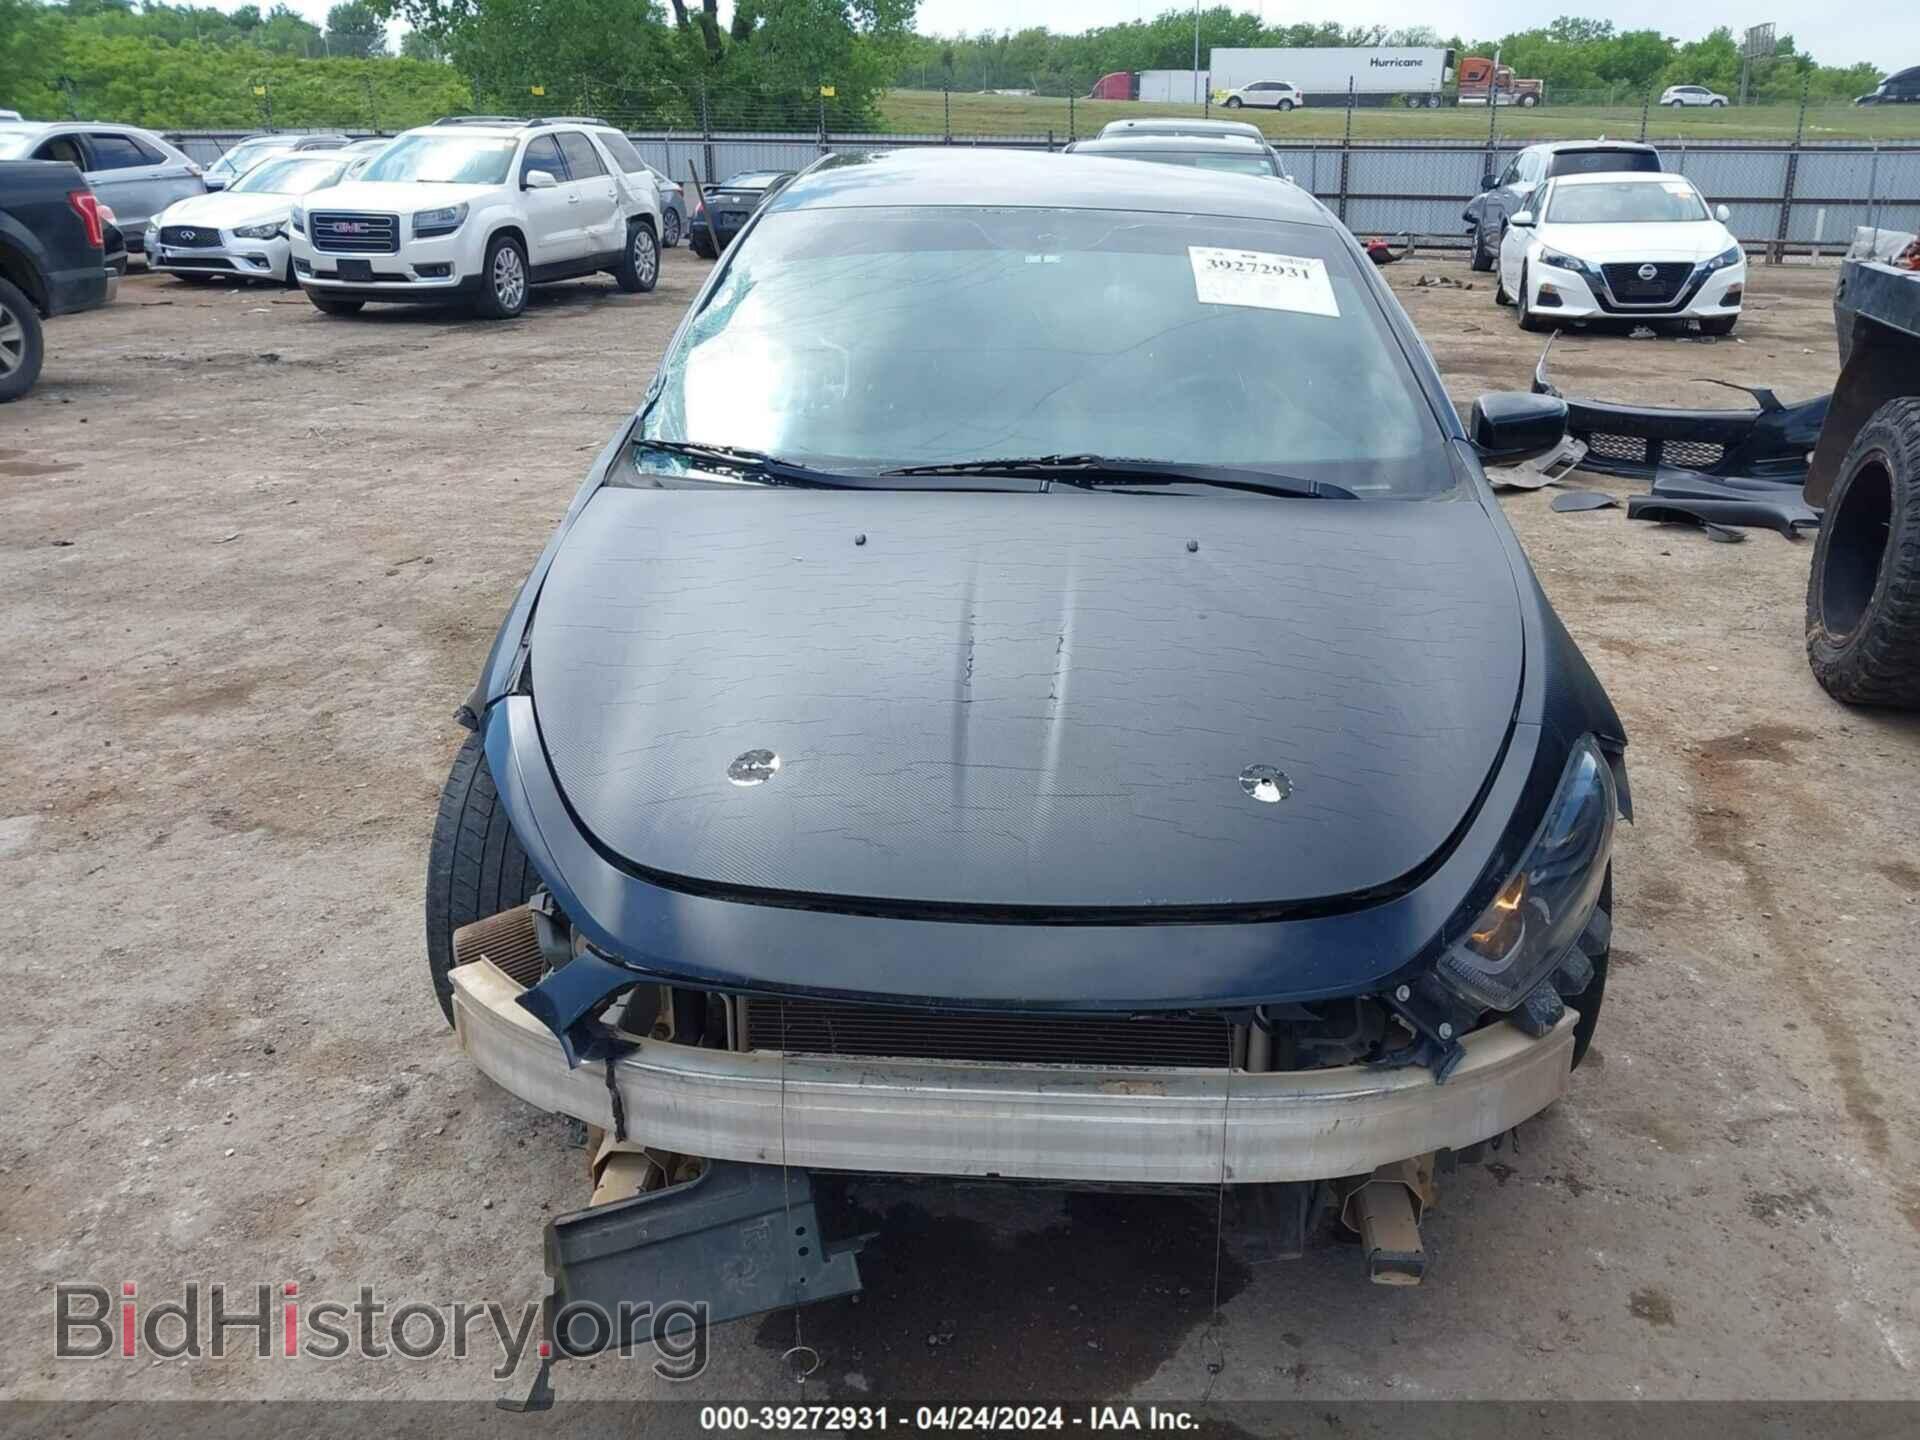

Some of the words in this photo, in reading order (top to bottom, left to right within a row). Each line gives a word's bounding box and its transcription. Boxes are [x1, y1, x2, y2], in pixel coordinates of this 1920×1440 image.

[1370, 57, 1423, 67] Hurricane
[333, 222, 369, 233] GMC
[1207, 258, 1310, 280] 39272931
